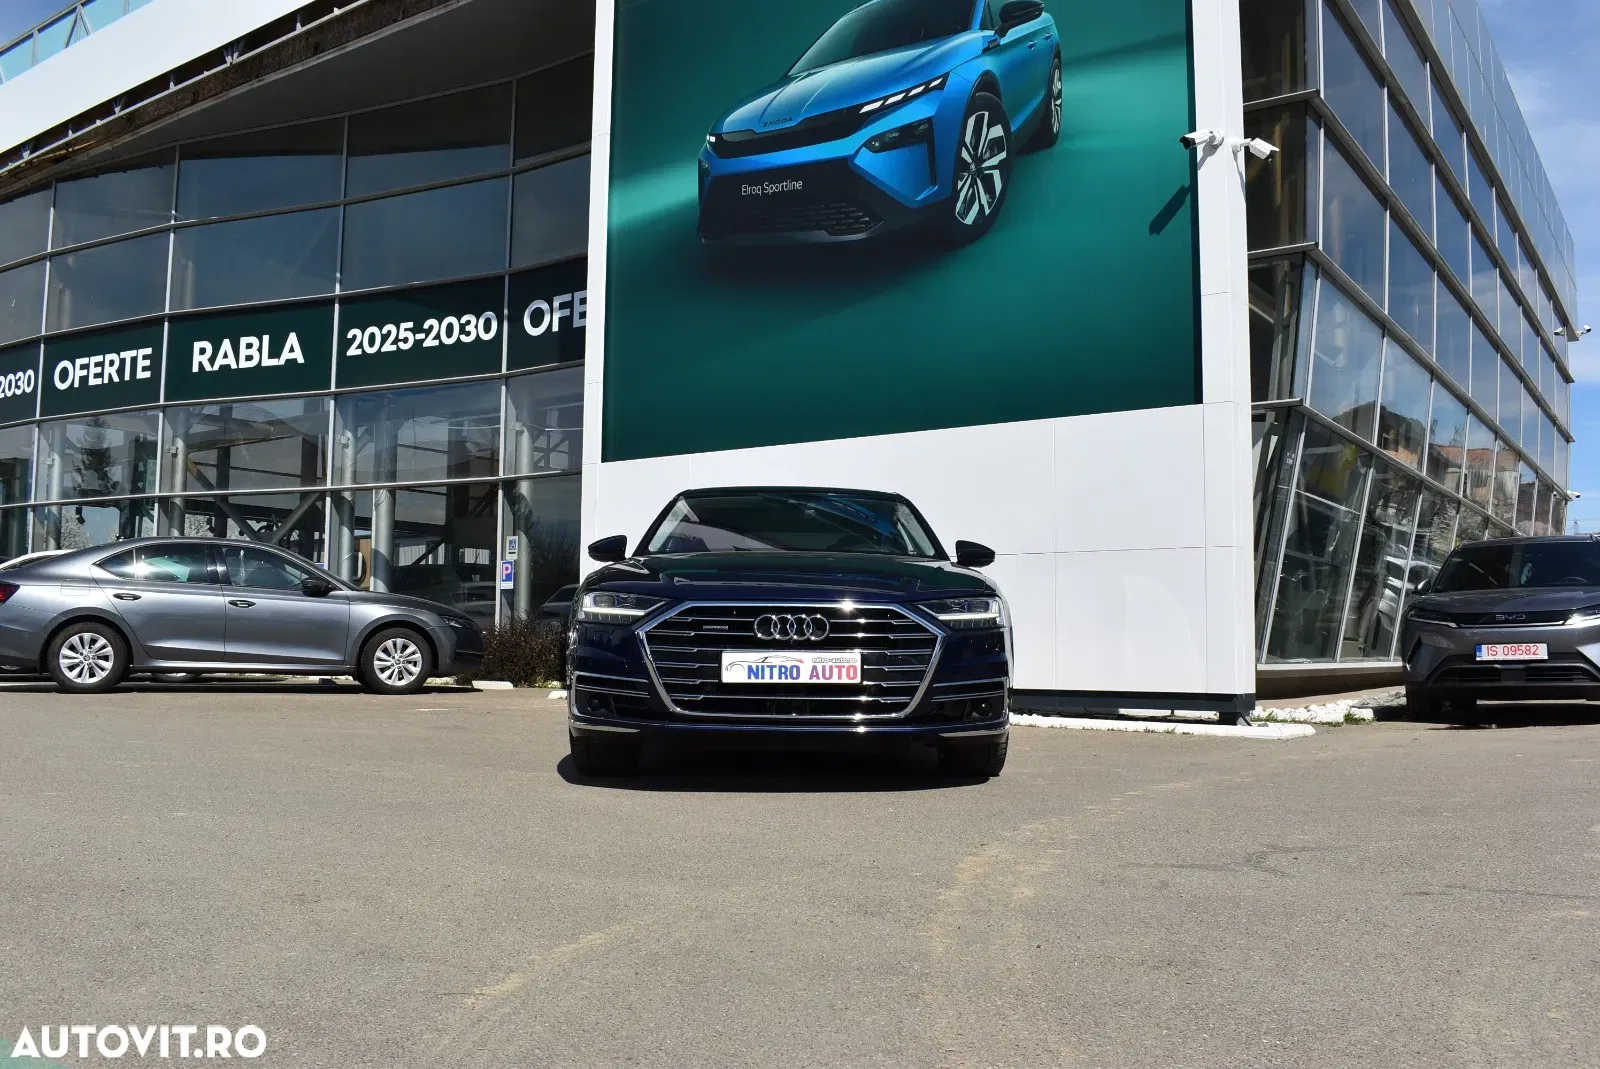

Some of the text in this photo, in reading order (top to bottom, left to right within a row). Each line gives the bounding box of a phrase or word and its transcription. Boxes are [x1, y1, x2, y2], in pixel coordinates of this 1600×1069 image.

[741, 180, 802, 196] Elroq Sportline
[54, 348, 152, 390] OFERTE
[192, 332, 305, 372] RABLA
[346, 311, 498, 356] 2025-2030
[502, 563, 512, 580] P
[1486, 645, 1498, 657] IS
[1502, 645, 1539, 656] 09582
[811, 656, 858, 664] nitro-auto.ro
[747, 664, 858, 680] NITRO AUTO
